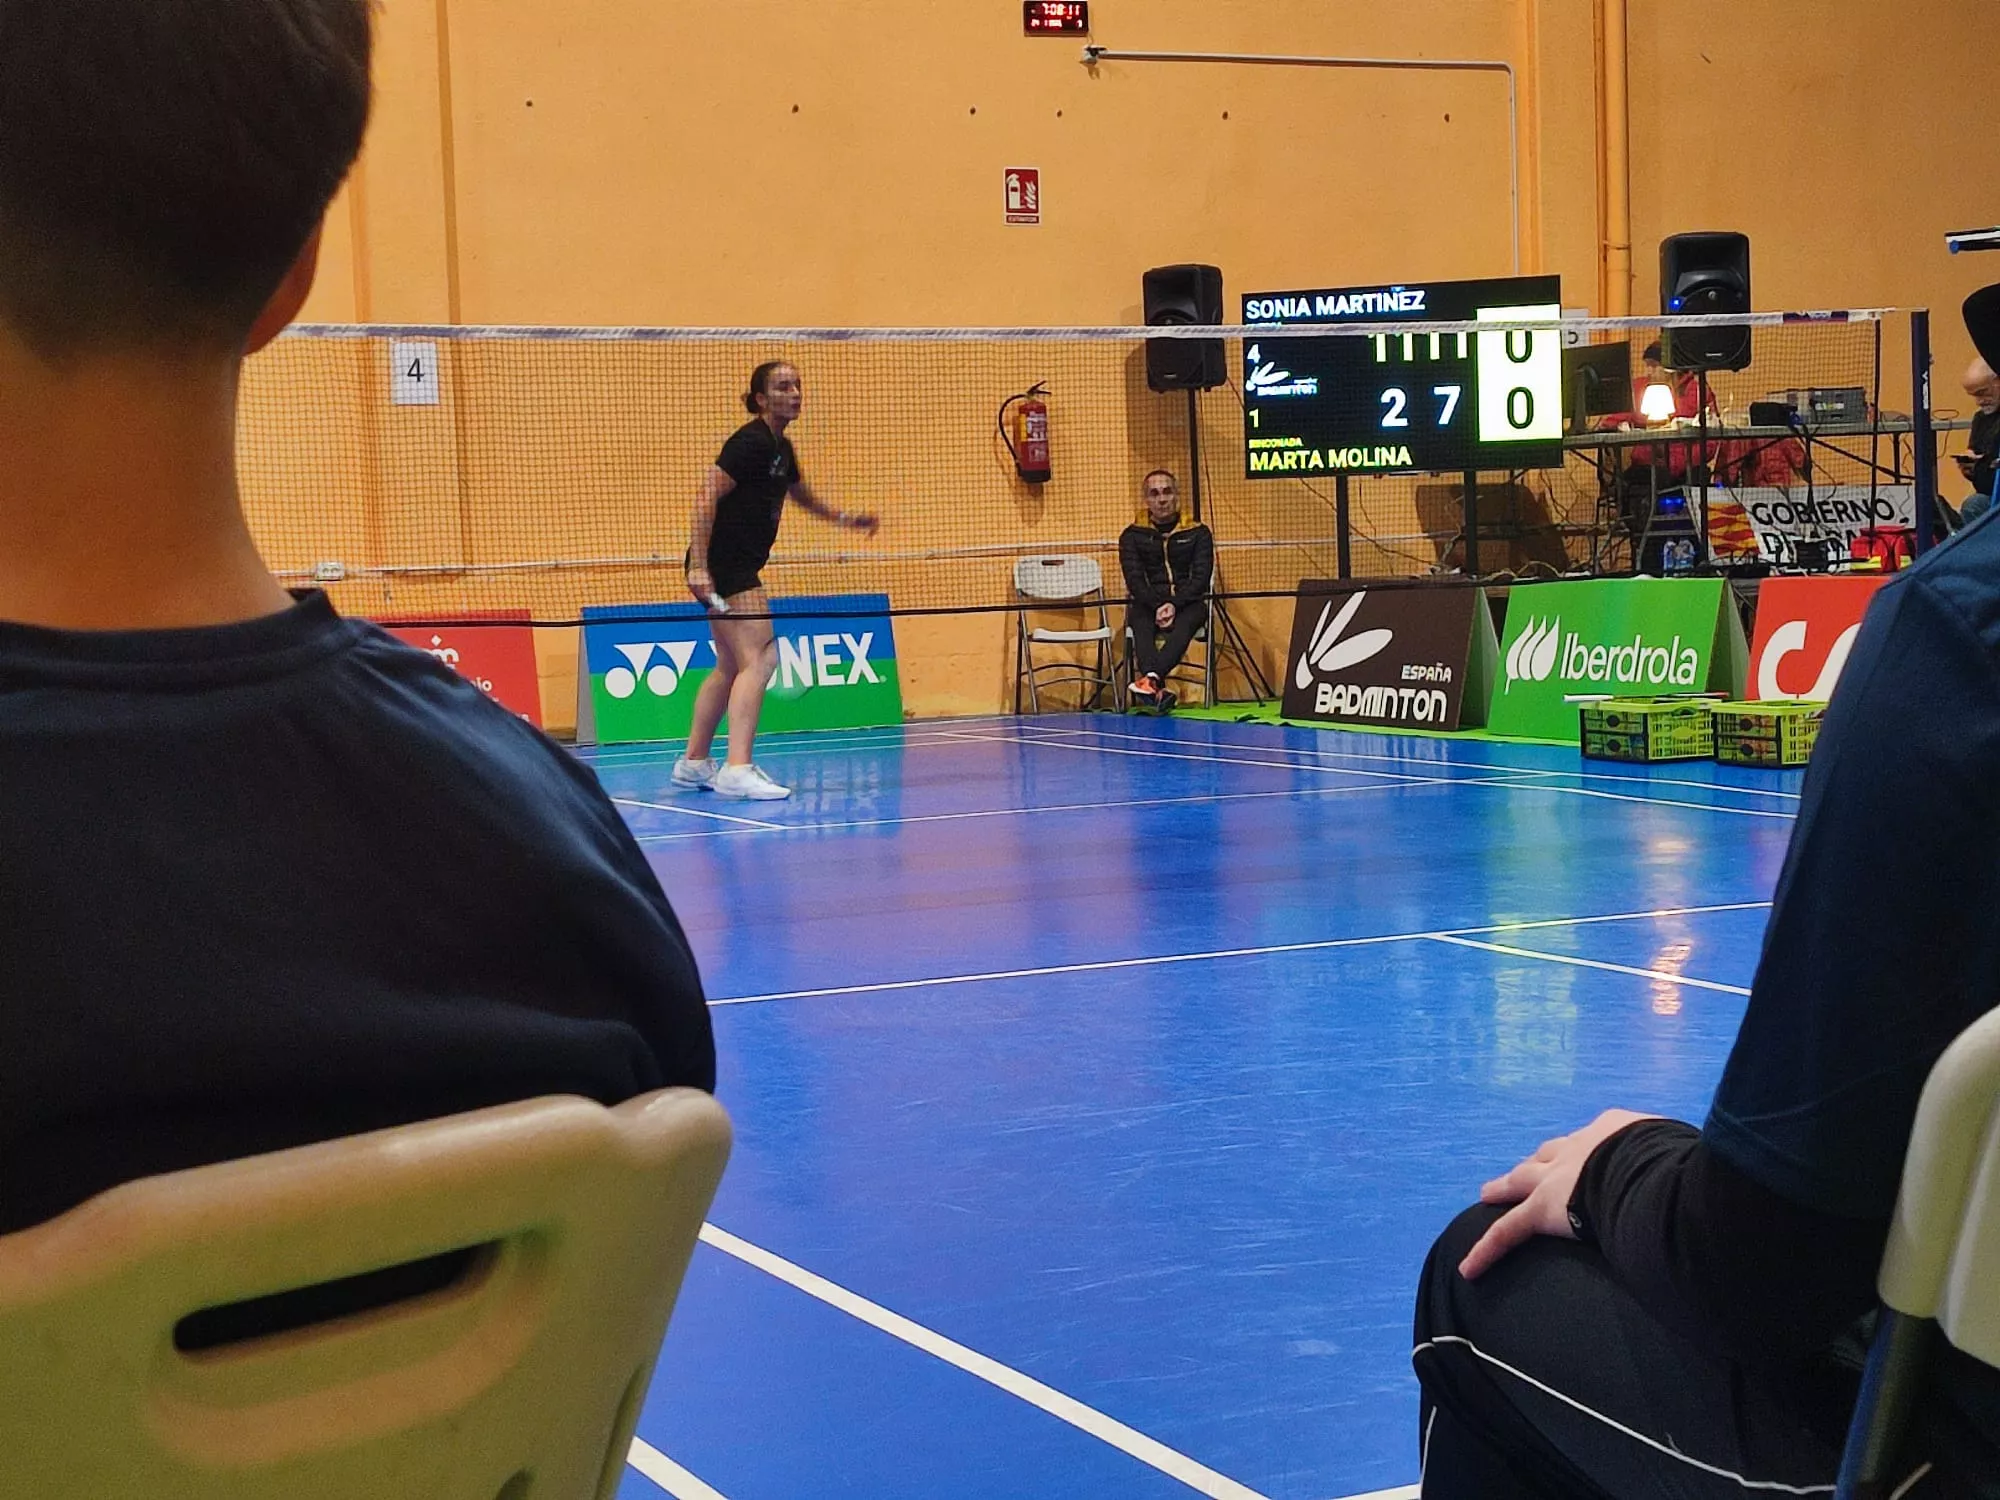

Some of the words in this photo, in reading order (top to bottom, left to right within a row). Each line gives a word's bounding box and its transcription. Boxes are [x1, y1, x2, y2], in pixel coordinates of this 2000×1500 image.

[1246, 297, 1312, 320] SONIA
[1247, 344, 1261, 364] 4
[407, 357, 425, 382] 4
[1248, 408, 1259, 428] 1
[1380, 387, 1410, 428] 2
[1433, 385, 1462, 426] 7
[1506, 386, 1534, 430] 0
[1250, 450, 1325, 471] MARTA
[1328, 446, 1413, 469] MOLINA
[1560, 632, 1698, 685] Iberdrola
[1401, 662, 1452, 683] ESPAÑA
[1314, 682, 1447, 722] BADMINTON
